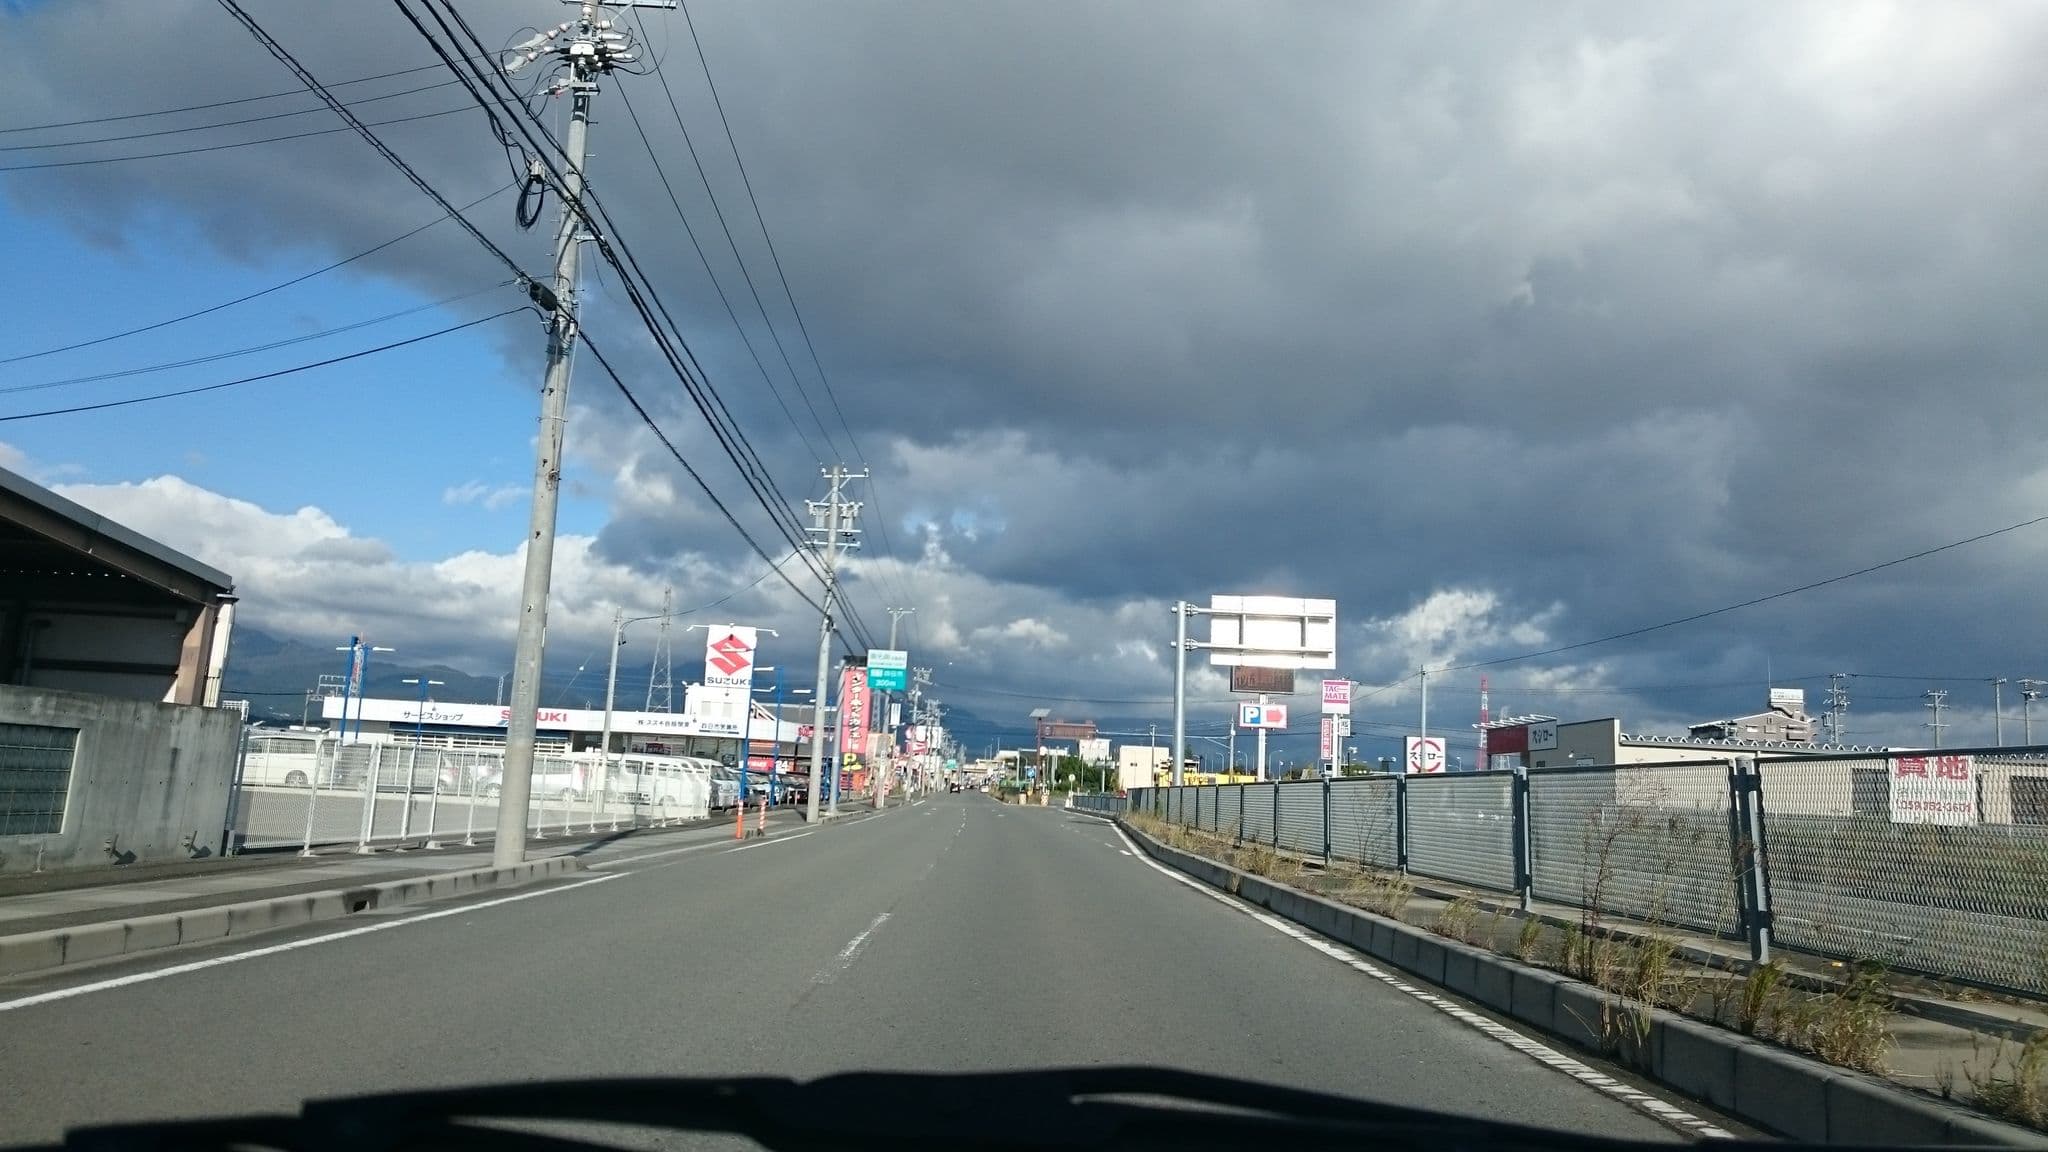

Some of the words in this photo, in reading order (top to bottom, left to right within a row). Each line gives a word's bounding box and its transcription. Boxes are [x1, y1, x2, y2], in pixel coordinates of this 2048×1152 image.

[707, 676, 752, 686] SUZUKI
[403, 711, 464, 721] サービスショップ
[1244, 706, 1260, 723] P
[1532, 729, 1553, 744] スシロー
